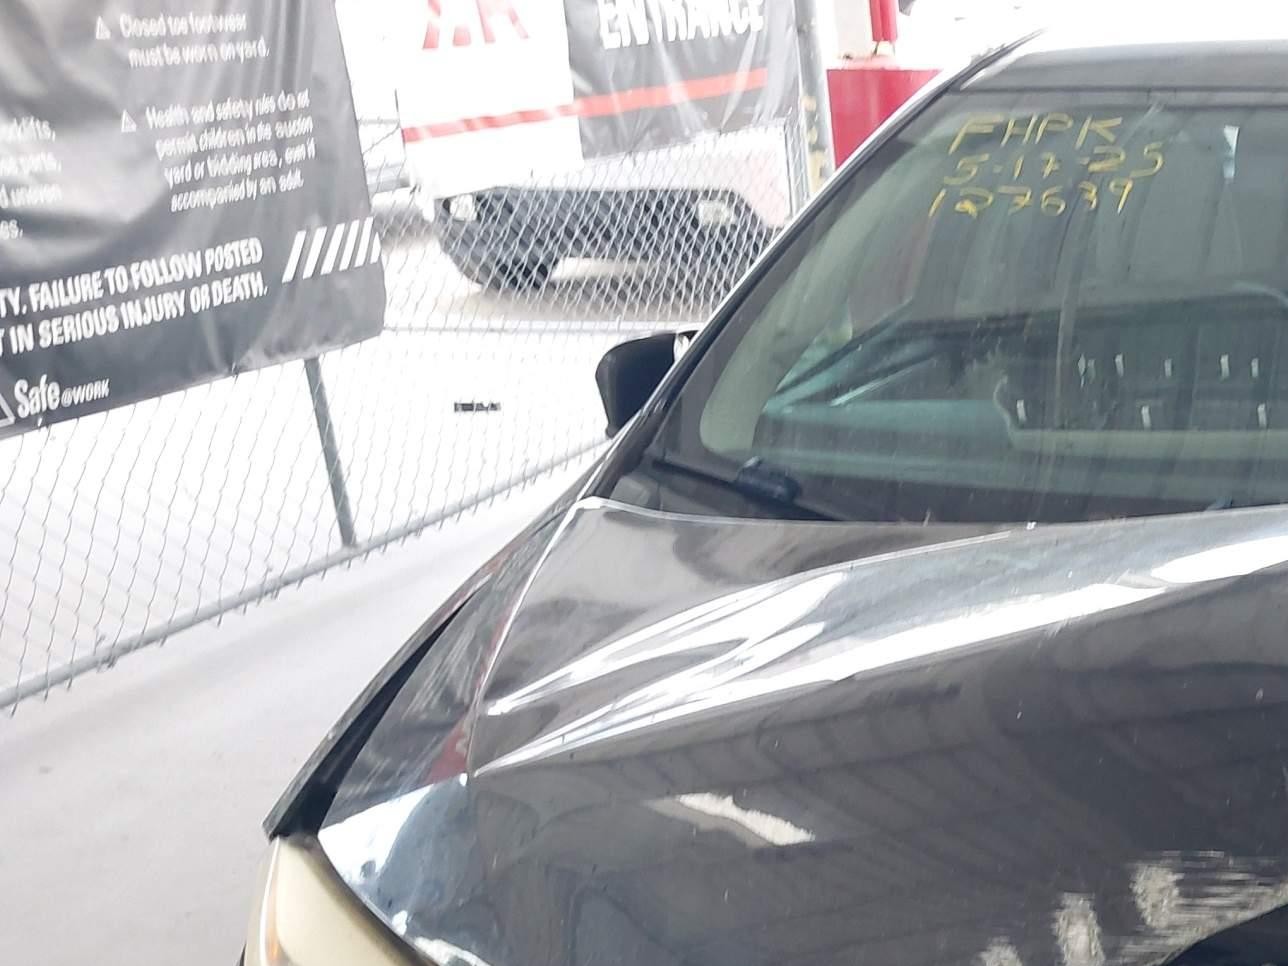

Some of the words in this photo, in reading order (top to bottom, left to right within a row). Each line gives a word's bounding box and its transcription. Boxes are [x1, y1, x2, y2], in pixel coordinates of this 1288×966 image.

[29, 270, 104, 312] FAILURE
[104, 265, 128, 295] TO
[130, 252, 201, 290] FOLLOW
[205, 237, 262, 274] POSTED
[9, 324, 35, 354] IN
[39, 304, 119, 348] SERIOUS
[120, 289, 186, 330] INJURY
[190, 283, 209, 313] OR
